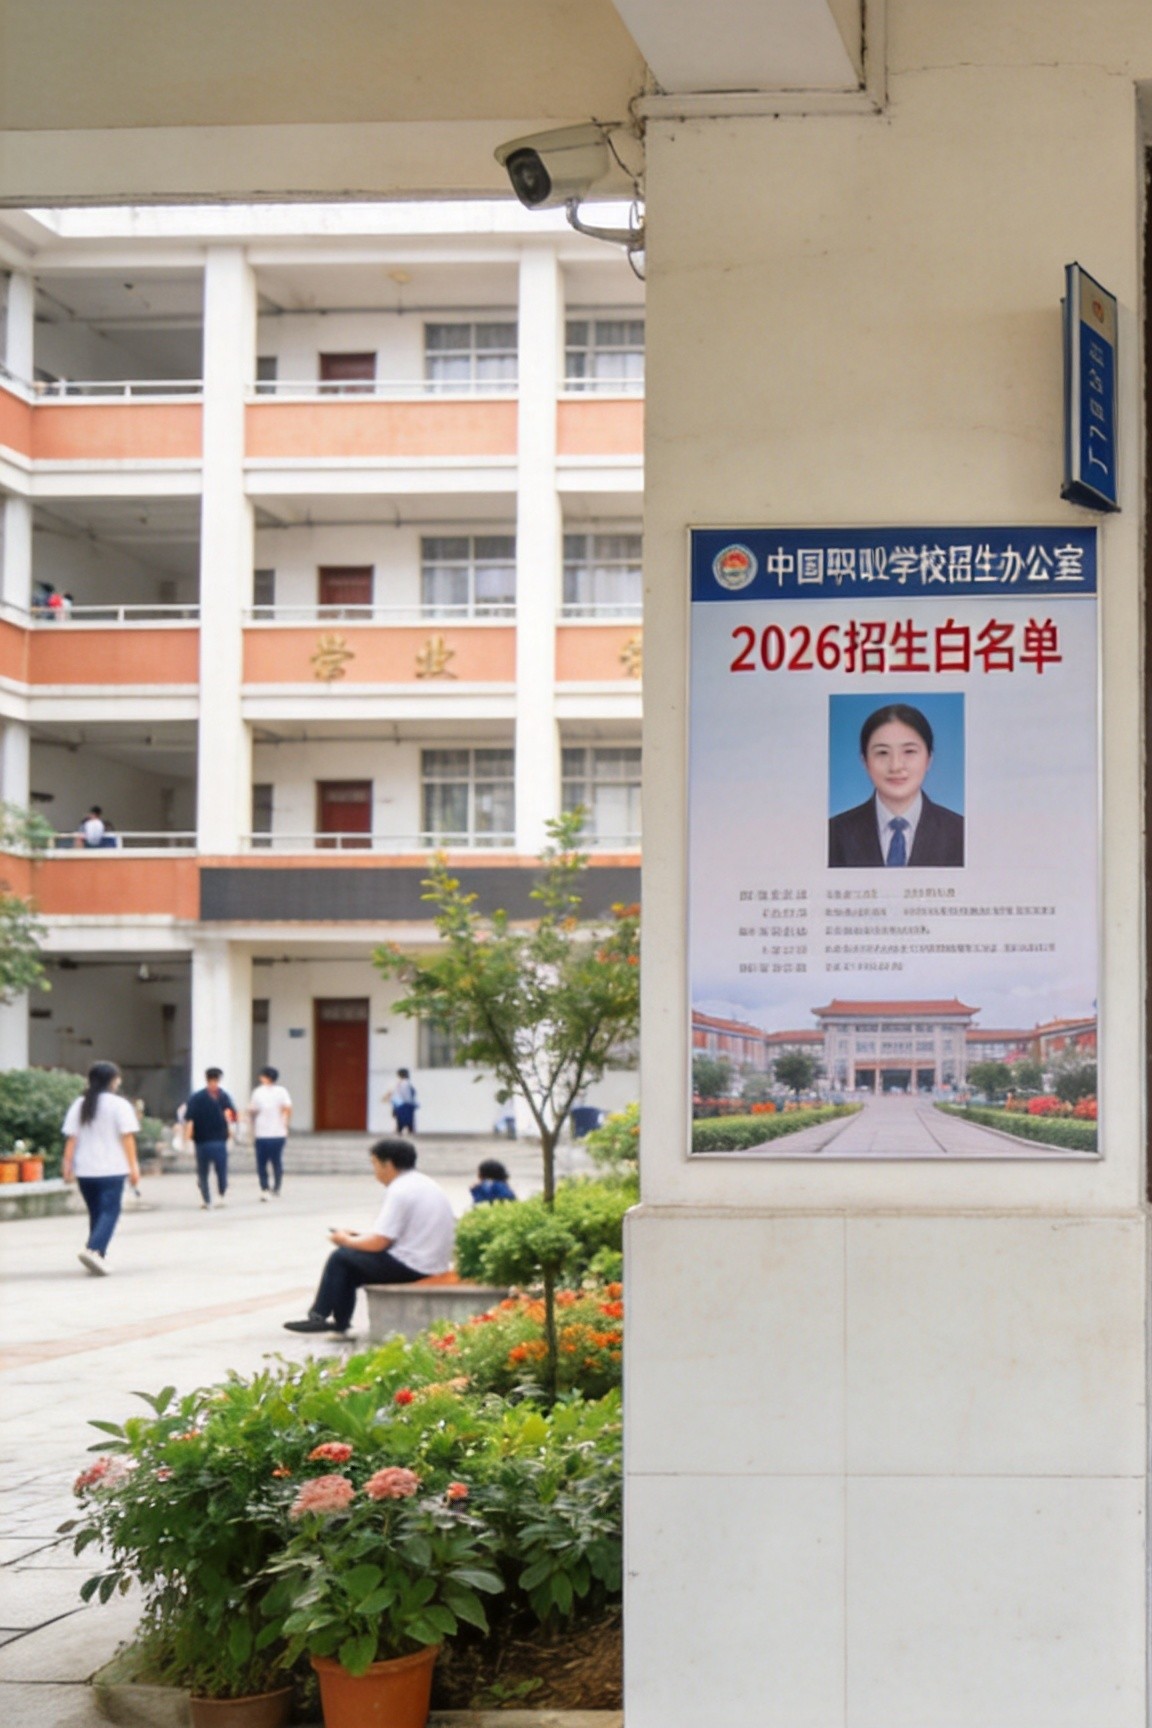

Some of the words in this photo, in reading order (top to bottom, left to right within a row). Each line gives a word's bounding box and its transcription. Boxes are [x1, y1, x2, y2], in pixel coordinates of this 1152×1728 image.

[730, 618, 1062, 674] 2026招生白名单
